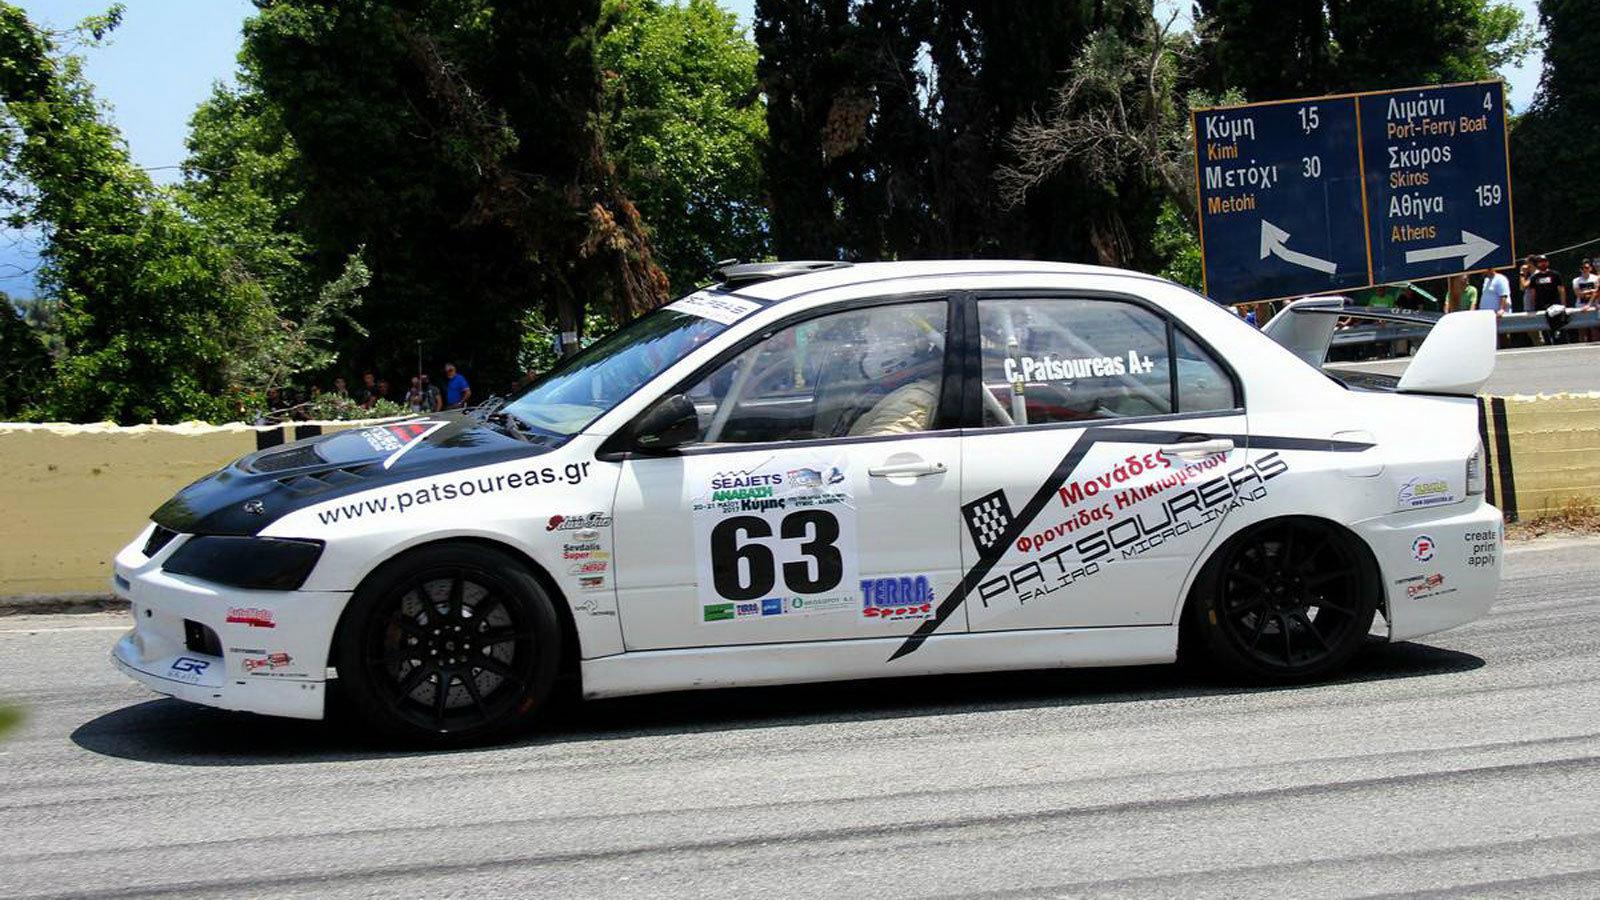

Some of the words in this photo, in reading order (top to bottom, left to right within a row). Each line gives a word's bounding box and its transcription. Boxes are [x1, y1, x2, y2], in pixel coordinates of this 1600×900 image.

[1387, 93, 1446, 120] Λιμάνι
[1482, 92, 1493, 112] 4
[1205, 115, 1255, 140] Κύμη
[1299, 106, 1320, 135] 1,5
[1387, 118, 1456, 140] Port-Ferry
[1460, 115, 1488, 132] Boat
[1207, 142, 1239, 161] Kimi
[1388, 141, 1451, 169] Σκύρος
[1205, 160, 1278, 190] Μετόχι
[1302, 155, 1321, 178] 30
[1389, 170, 1430, 189] Skiros
[1207, 194, 1256, 215] Metohi
[1389, 191, 1444, 220] Αθήνα
[1475, 185, 1501, 208] 159
[1391, 225, 1437, 243] Athens
[1004, 356, 1126, 383] C.Patsoureas
[1127, 350, 1154, 374] A+
[317, 459, 592, 526] www.patsoureas.gr
[711, 474, 783, 490] SEAJETS
[1057, 449, 1172, 508] Μονάδες
[741, 498, 786, 513] Κύμης
[1015, 503, 1115, 553] Φροντίδας
[1113, 451, 1229, 511] Ηλικιωμένων
[977, 451, 1290, 608] PATSOUREAS
[1464, 529, 1496, 542] create
[710, 509, 843, 601] 63
[1017, 561, 1100, 605] FALIRO
[1121, 486, 1268, 560] MICROLIMANO
